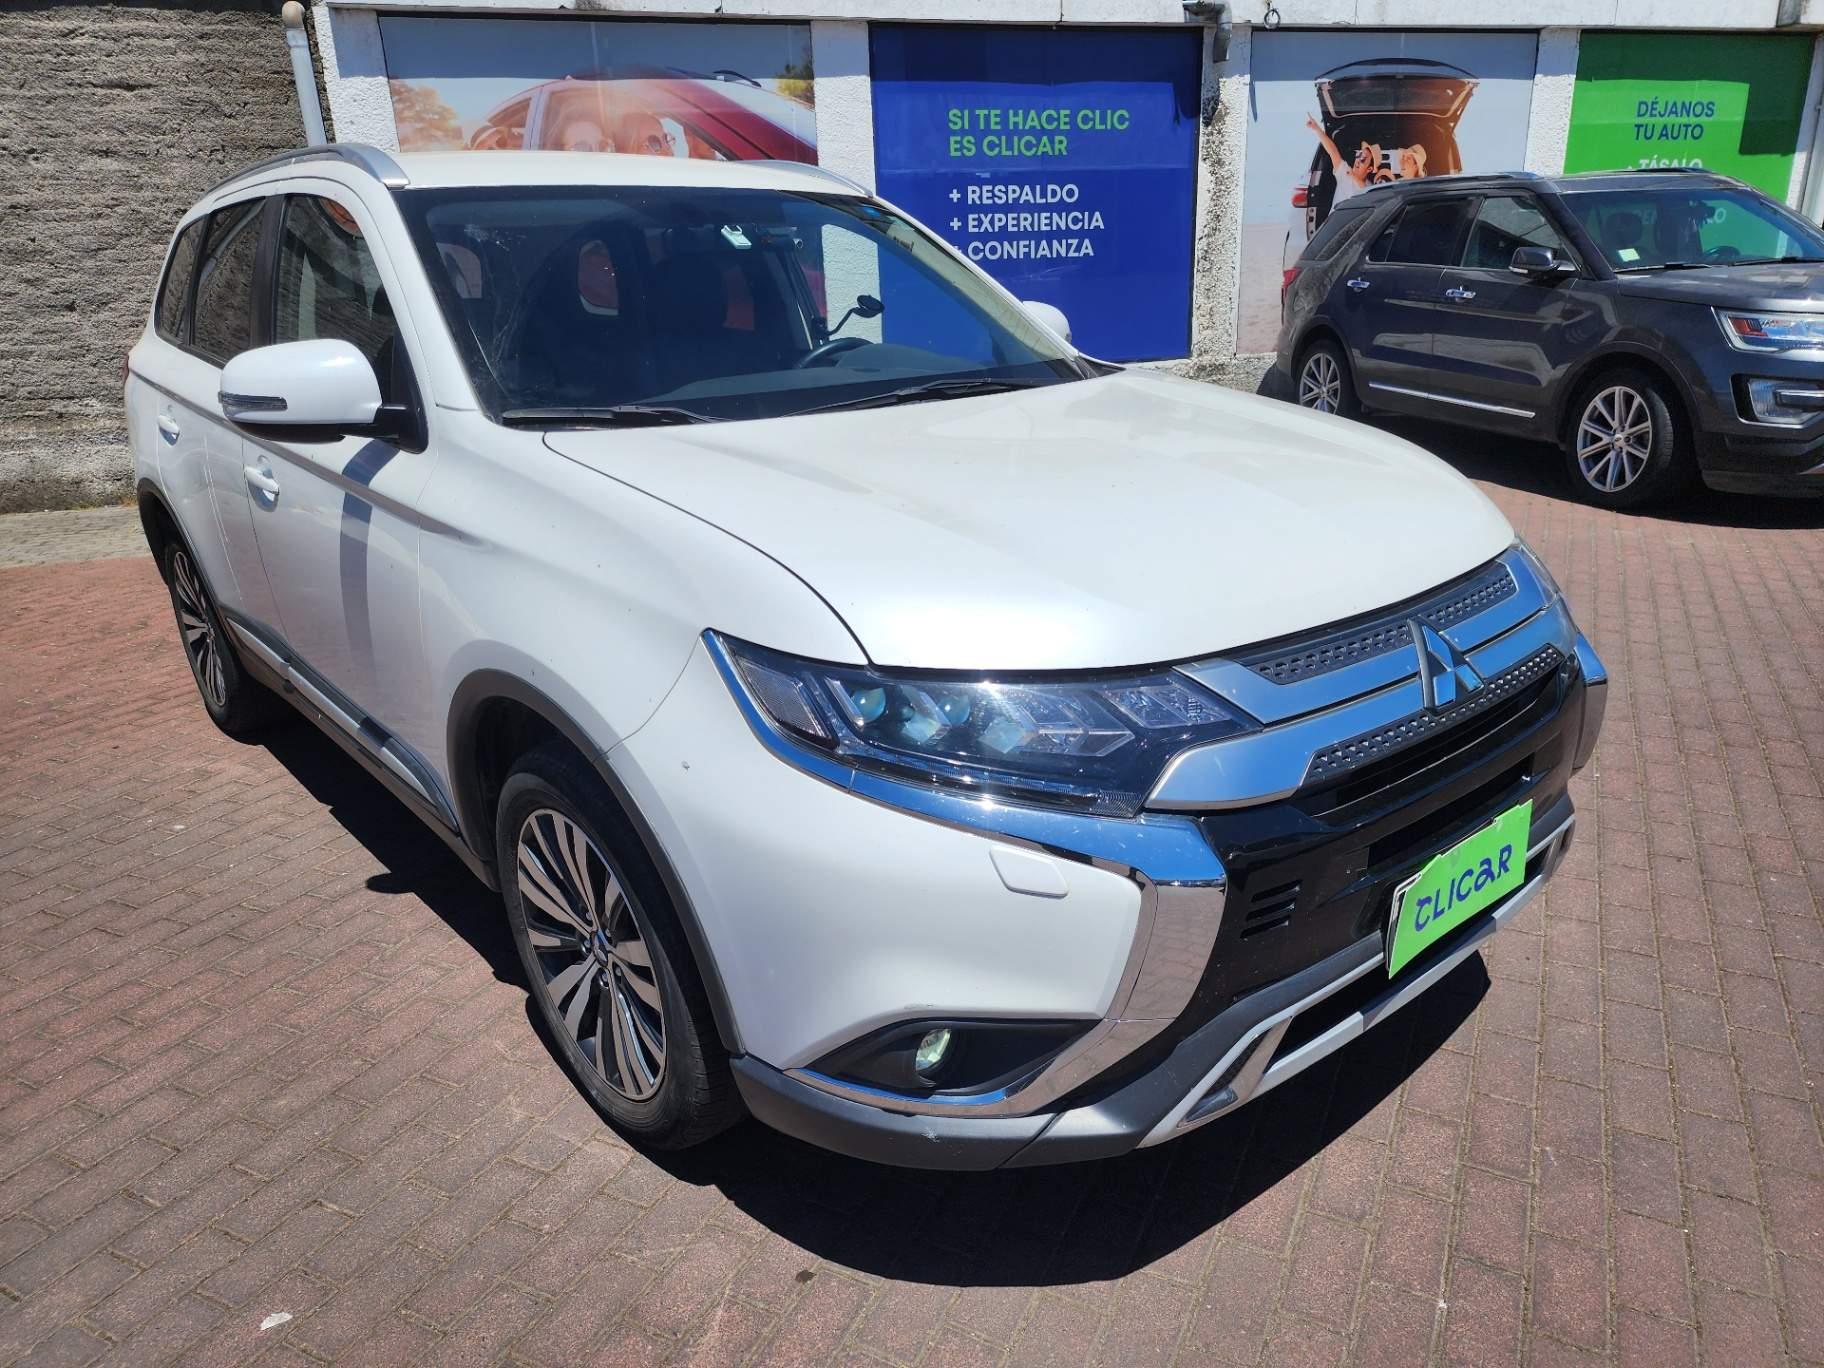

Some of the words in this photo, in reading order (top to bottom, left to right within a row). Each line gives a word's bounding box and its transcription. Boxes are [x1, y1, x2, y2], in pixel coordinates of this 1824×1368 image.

[1636, 96, 1715, 118] DÉJANOS
[948, 109, 969, 130] SI
[975, 109, 1001, 130] TE
[1008, 109, 1071, 130] HACE
[1077, 109, 1130, 130] CLIC
[1634, 124, 1656, 141] TU
[1657, 124, 1704, 141] AUTO
[950, 136, 977, 157] ES
[982, 136, 1068, 157] CLICAR
[967, 184, 1079, 205] RESPALDO
[967, 211, 1105, 233] EXPERIENCIA
[967, 238, 1095, 261] CONFIANZA
